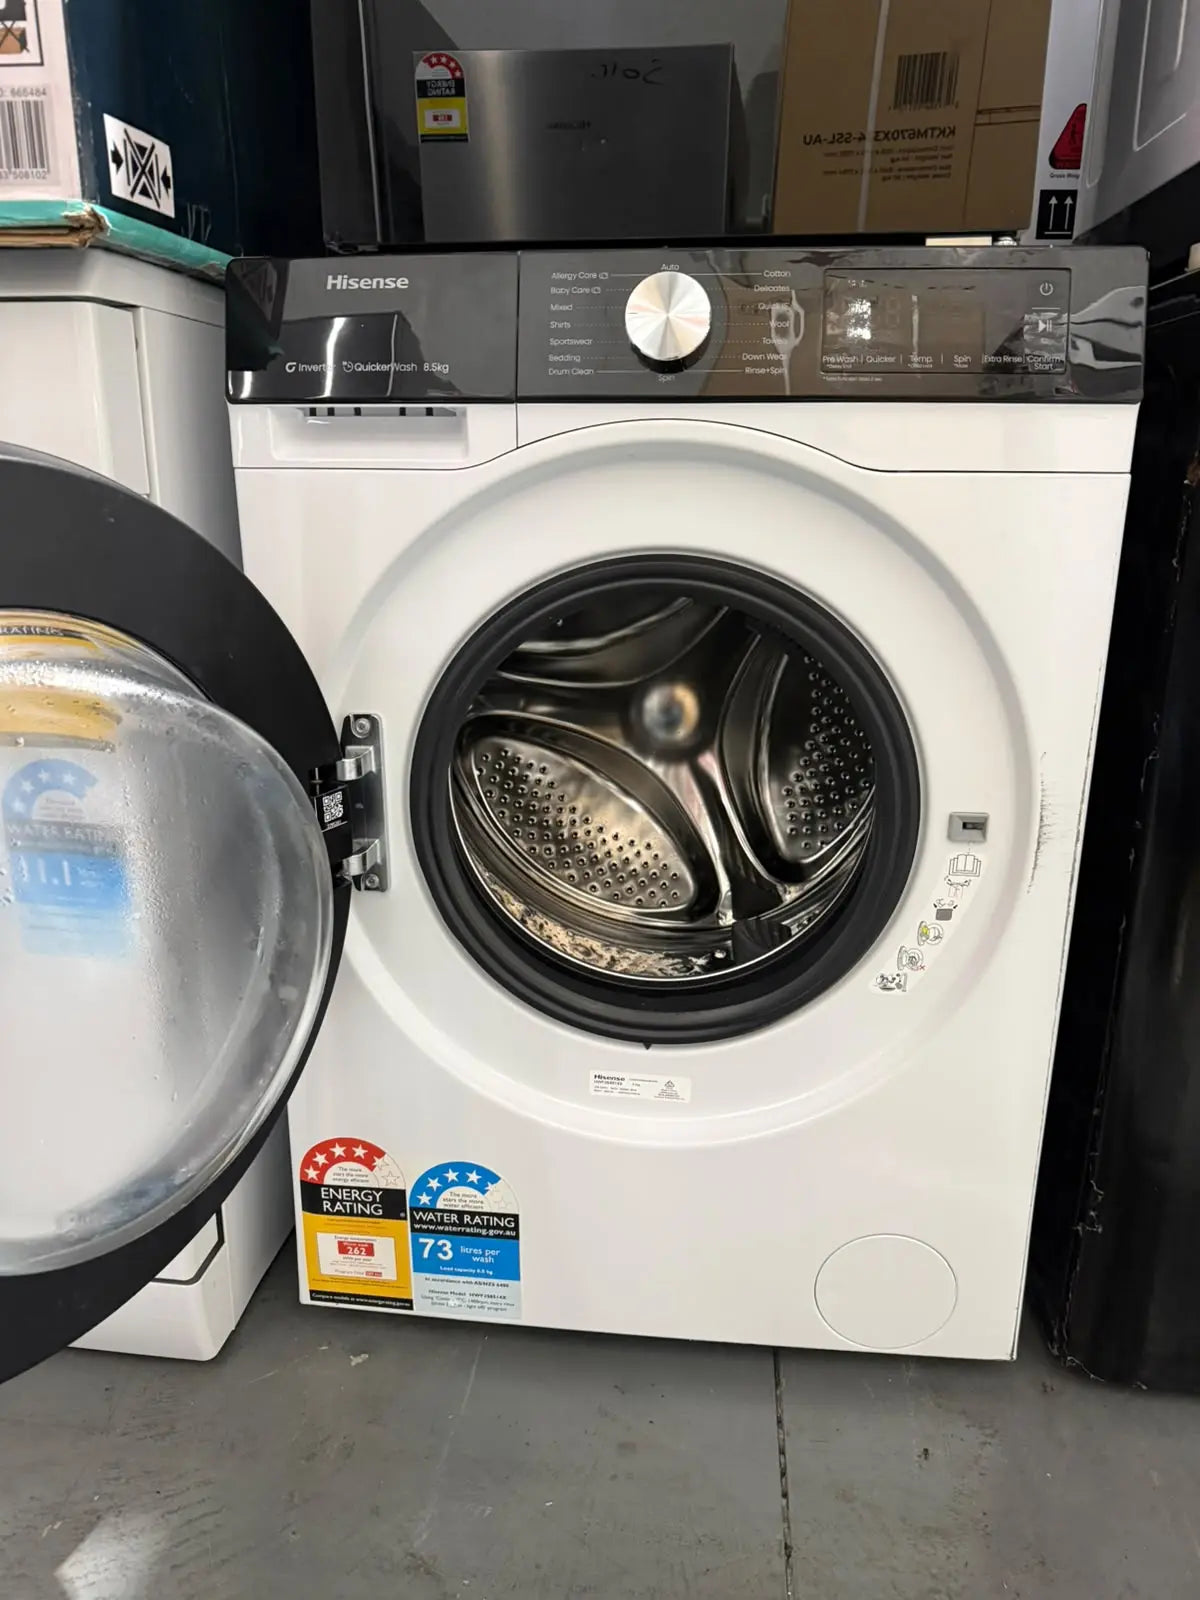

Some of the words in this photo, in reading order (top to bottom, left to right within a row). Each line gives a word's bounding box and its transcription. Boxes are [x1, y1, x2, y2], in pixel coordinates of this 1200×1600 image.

[660, 263, 680, 271] Auto
[551, 272, 577, 281] Allergy
[578, 271, 597, 279] Care
[763, 270, 791, 278] Cotton
[326, 274, 409, 291] Hisense
[550, 286, 570, 296] Baby
[571, 286, 590, 294] Care
[753, 284, 790, 292] Delicates
[550, 303, 573, 311] Mixed
[550, 320, 571, 329] Shirts
[549, 337, 593, 346] Sportswear
[549, 354, 581, 363] Bedding
[742, 353, 765, 361] Down
[823, 355, 835, 363] Pre
[837, 354, 858, 362] Wash
[866, 355, 896, 363] Quicker
[953, 354, 971, 364] Spin
[985, 355, 1001, 363] Extra
[1003, 355, 1023, 363] Rinse
[423, 361, 449, 374] 8.5kg
[321, 1187, 384, 1203] ENERGY
[322, 1200, 384, 1216] RATING
[413, 1210, 460, 1224] WATER
[463, 1213, 516, 1229] RATING
[413, 1223, 517, 1237] www.waterrating.gov.au
[346, 1246, 367, 1256] 262
[418, 1237, 454, 1261] 73
[460, 1245, 482, 1255] litres
[485, 1248, 501, 1257] per
[472, 1256, 495, 1264] wash
